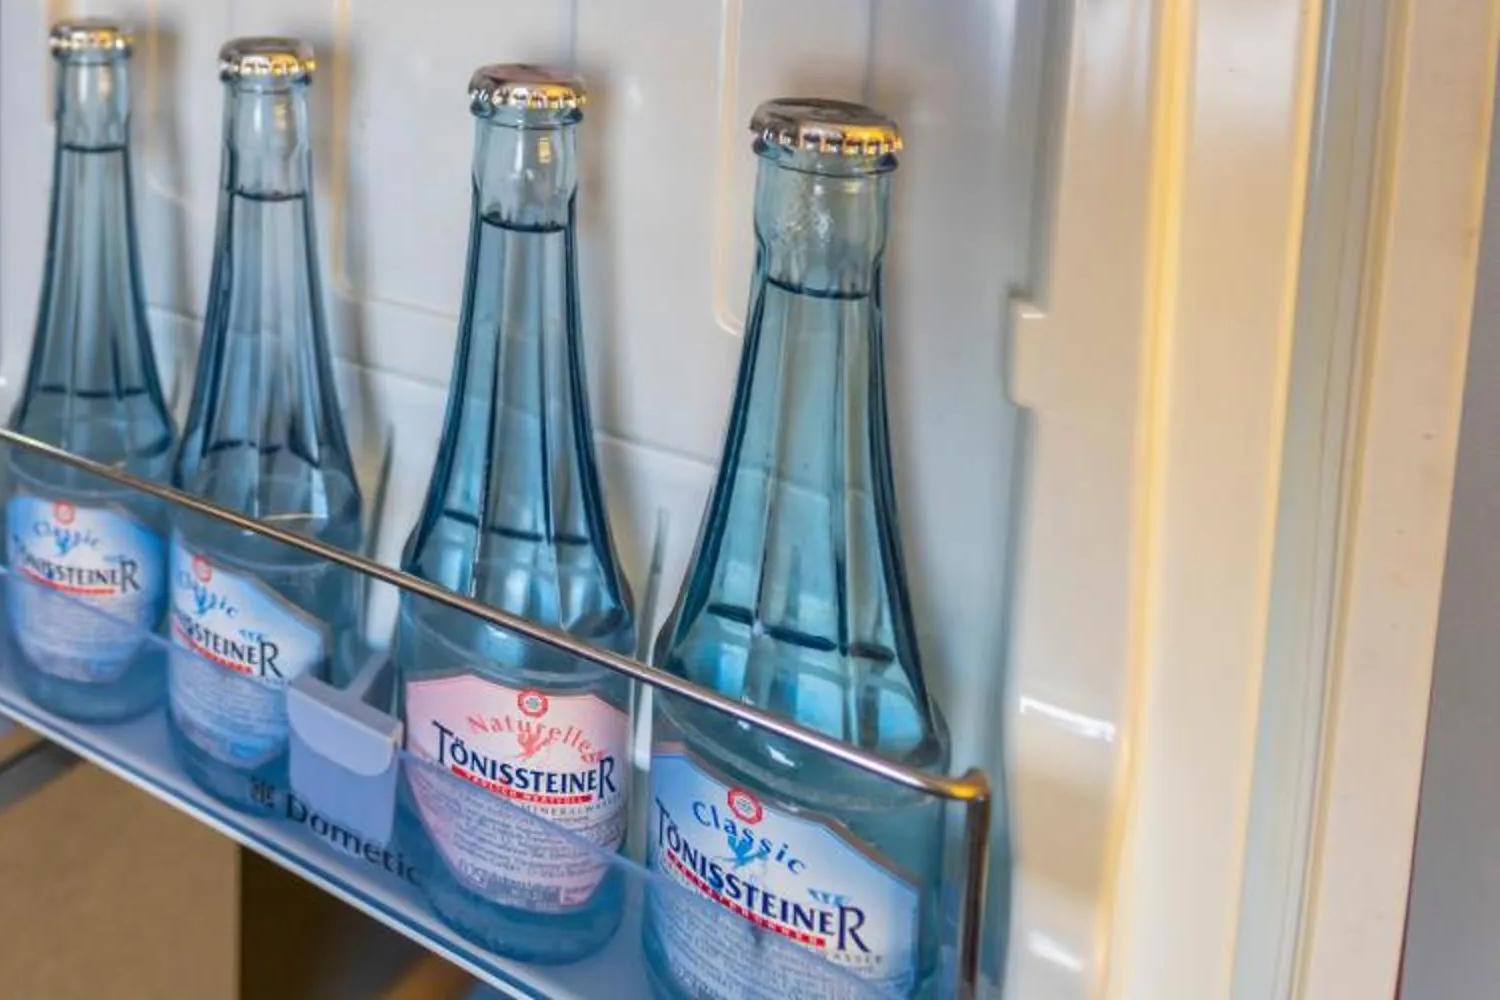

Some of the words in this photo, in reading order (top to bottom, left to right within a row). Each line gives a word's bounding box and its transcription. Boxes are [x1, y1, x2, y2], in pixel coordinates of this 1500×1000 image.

[431, 719, 617, 799] TÖNISSTEINER
[286, 793, 423, 888] Dometic
[692, 800, 808, 877] Classic
